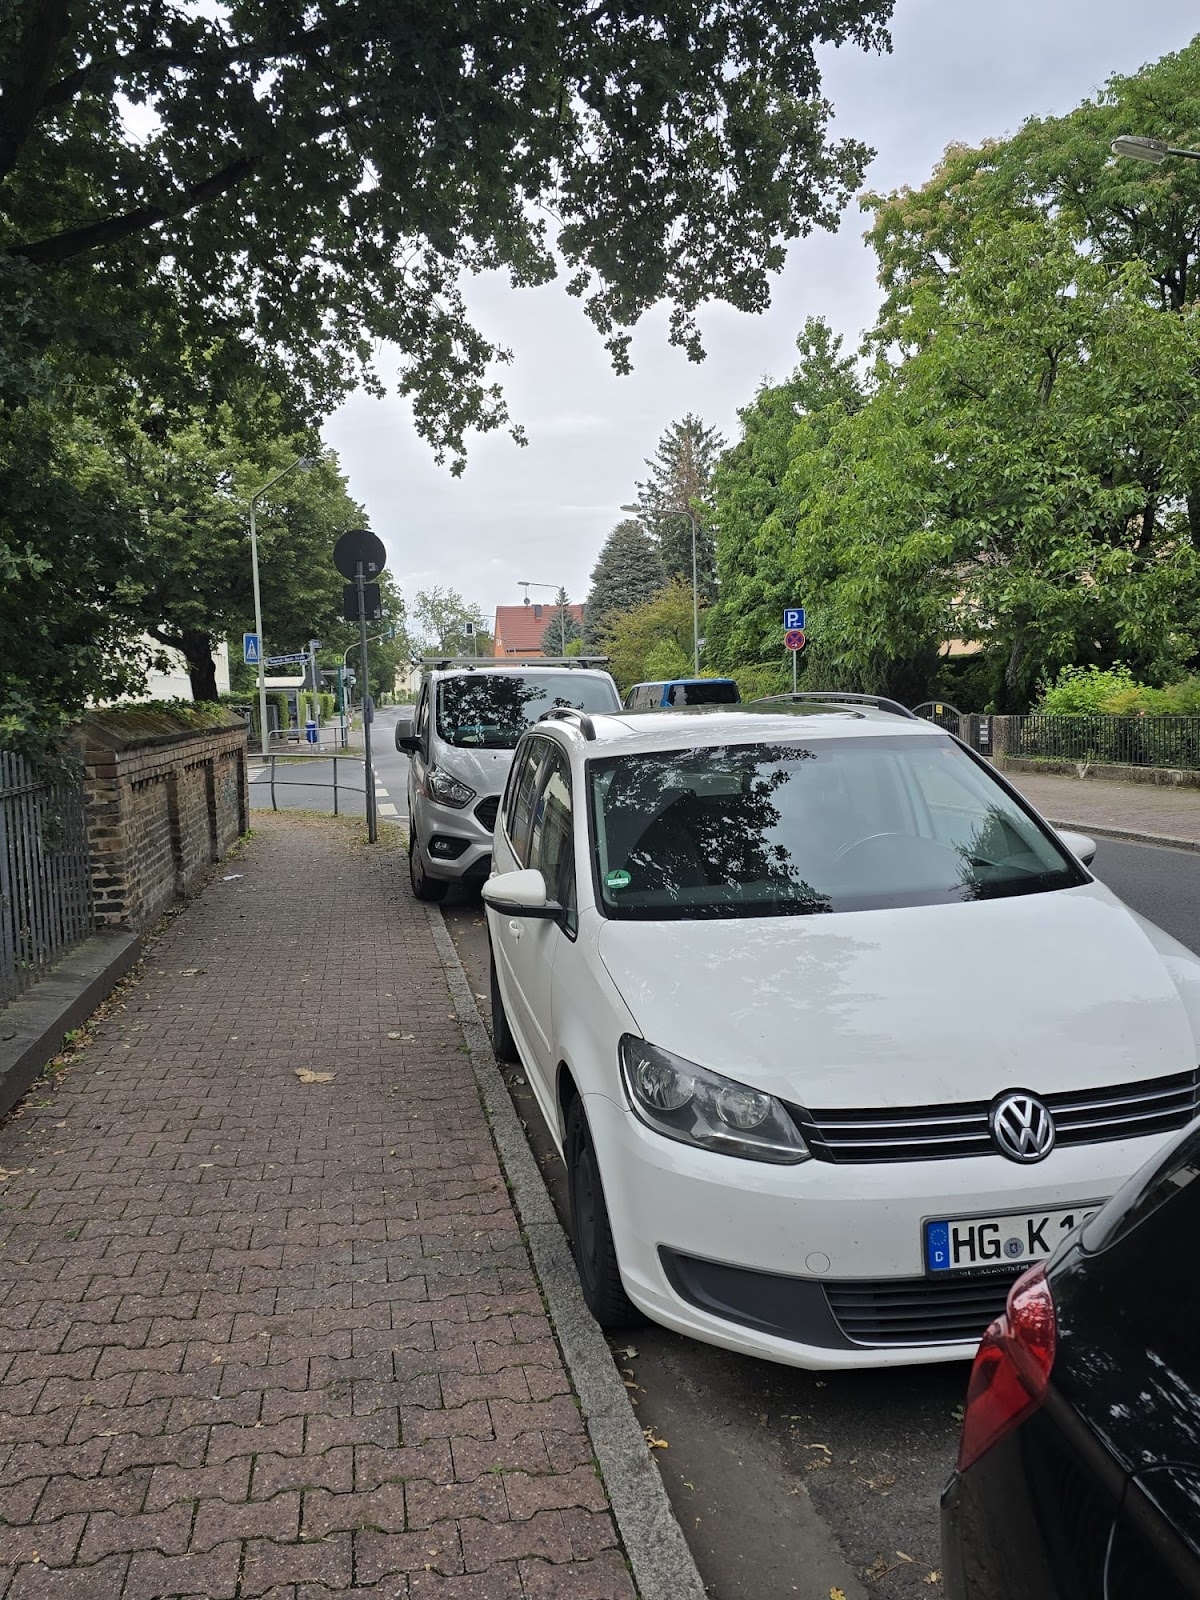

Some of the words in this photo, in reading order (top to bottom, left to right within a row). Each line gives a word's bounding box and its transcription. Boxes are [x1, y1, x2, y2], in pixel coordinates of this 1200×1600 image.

[787, 611, 799, 628] P
[996, 1097, 1053, 1156] VW
[952, 1223, 1002, 1263] HG
[1027, 1217, 1051, 1254] K
[935, 1251, 944, 1262] D
